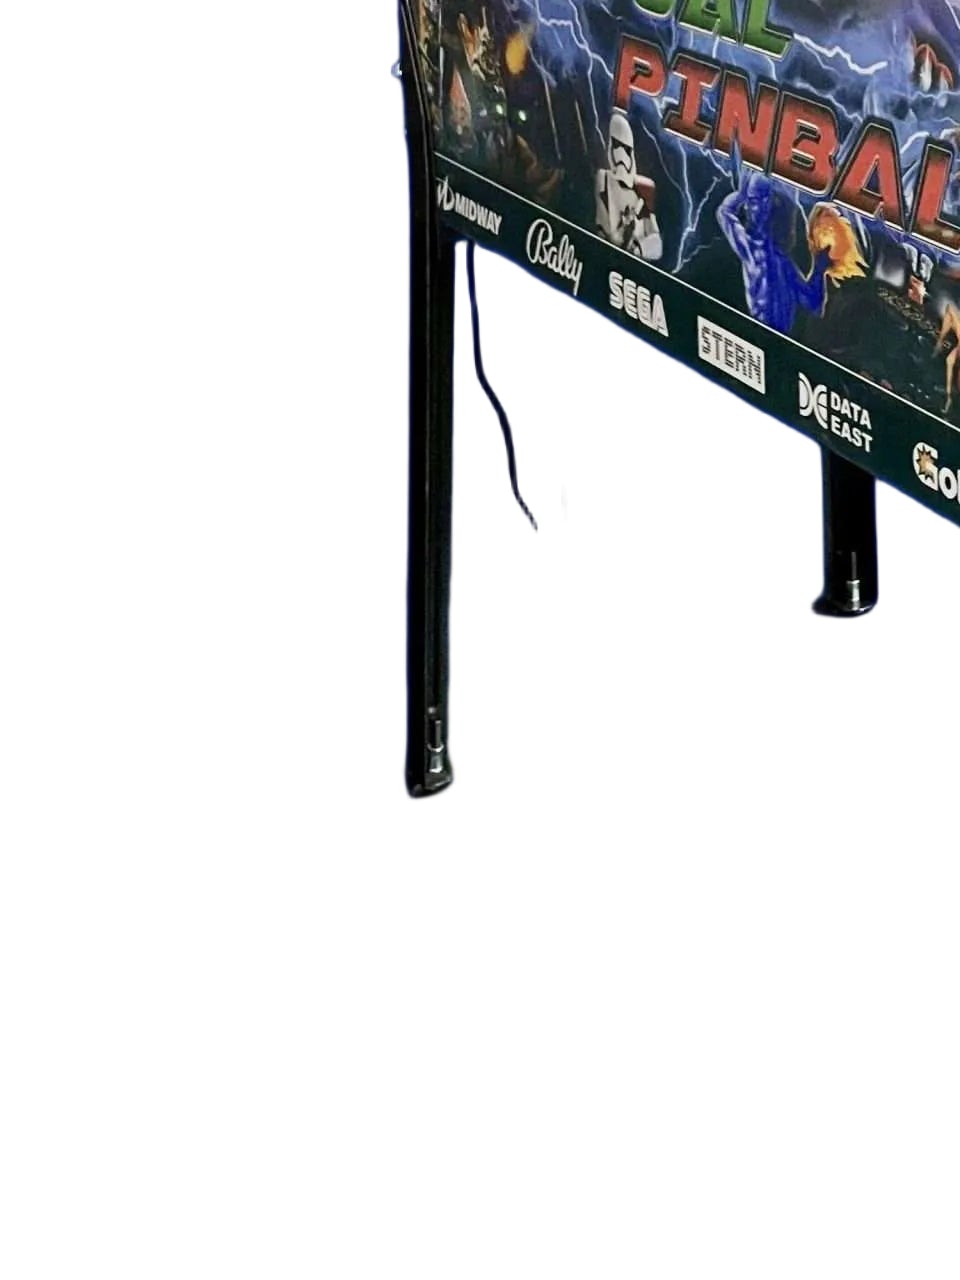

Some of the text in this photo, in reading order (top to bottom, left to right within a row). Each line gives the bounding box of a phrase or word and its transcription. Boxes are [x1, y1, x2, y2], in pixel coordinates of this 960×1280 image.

[454, 192, 503, 236] MIDWAY
[525, 218, 584, 297] Bally
[608, 270, 670, 338] SEGA
[699, 322, 763, 387] STERN
[829, 390, 873, 431] DATA
[830, 413, 875, 454] EAST
